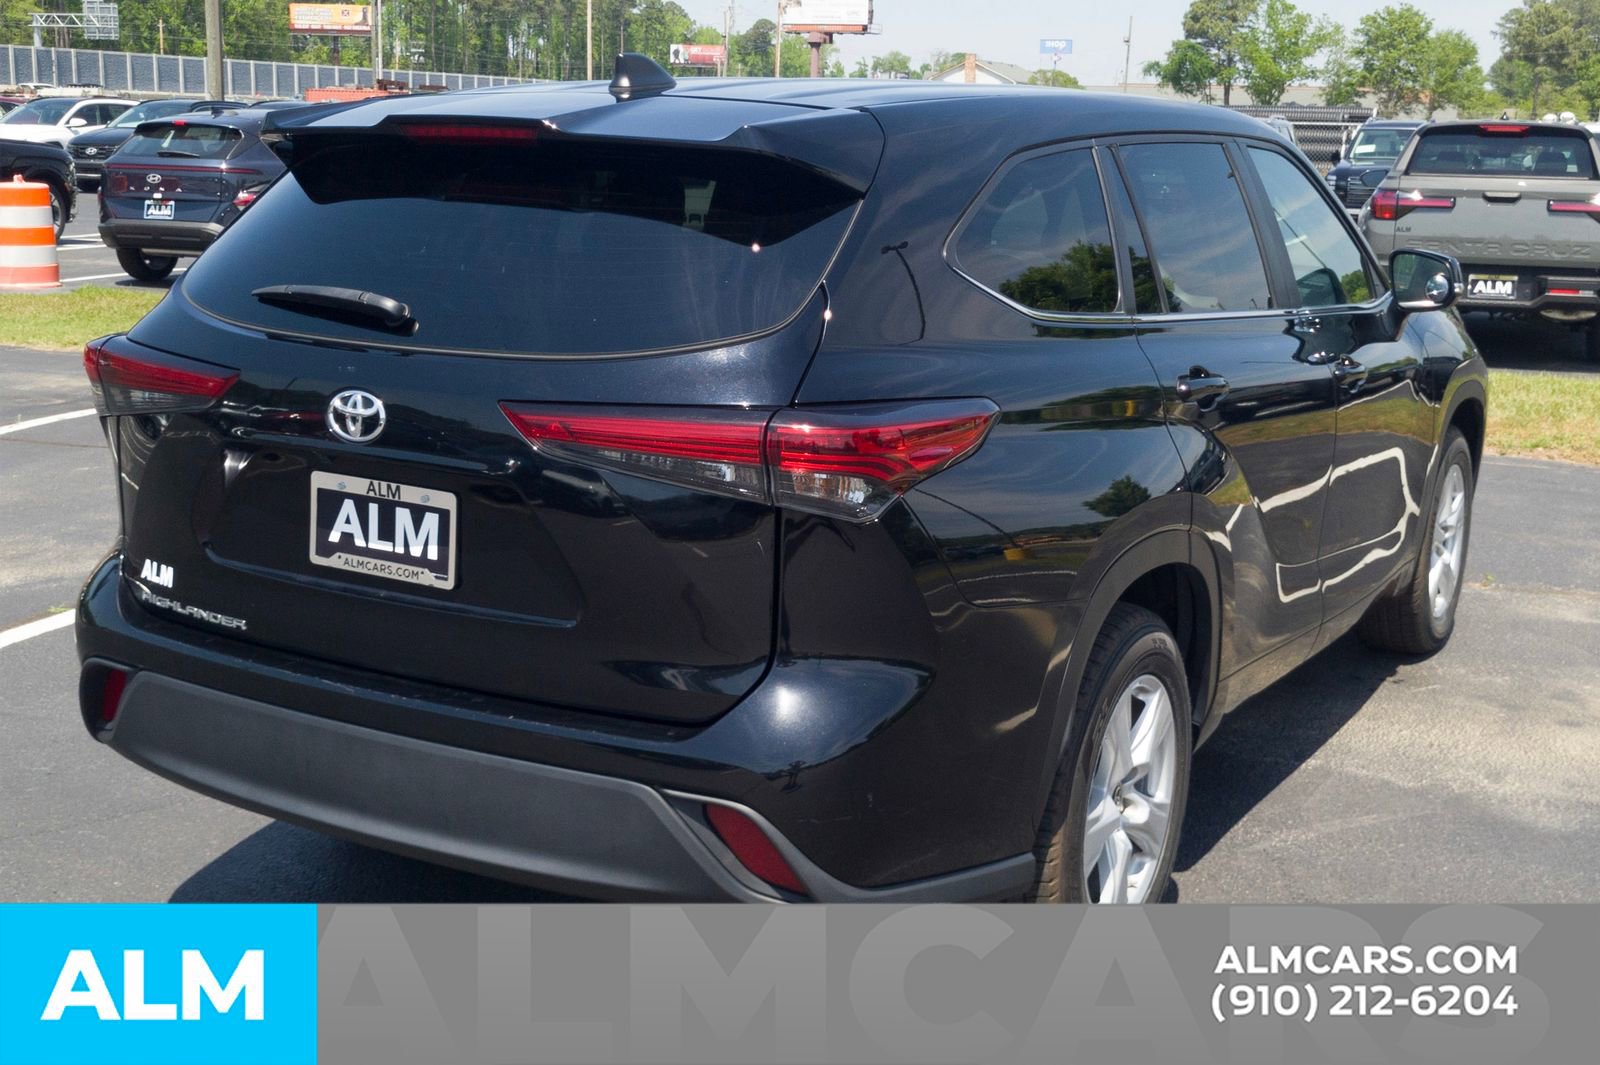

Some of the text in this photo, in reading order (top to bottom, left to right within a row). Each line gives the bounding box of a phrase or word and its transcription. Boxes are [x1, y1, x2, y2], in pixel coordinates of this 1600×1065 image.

[147, 205, 171, 215] ALM
[1509, 241, 1592, 258] CRUZ
[1473, 280, 1513, 294] ALM
[366, 480, 401, 500] ALM
[328, 498, 440, 561] ALM
[140, 558, 174, 588] ALM
[343, 557, 420, 580] ALMCARS.COM
[141, 592, 248, 631] HIGHLANDER
